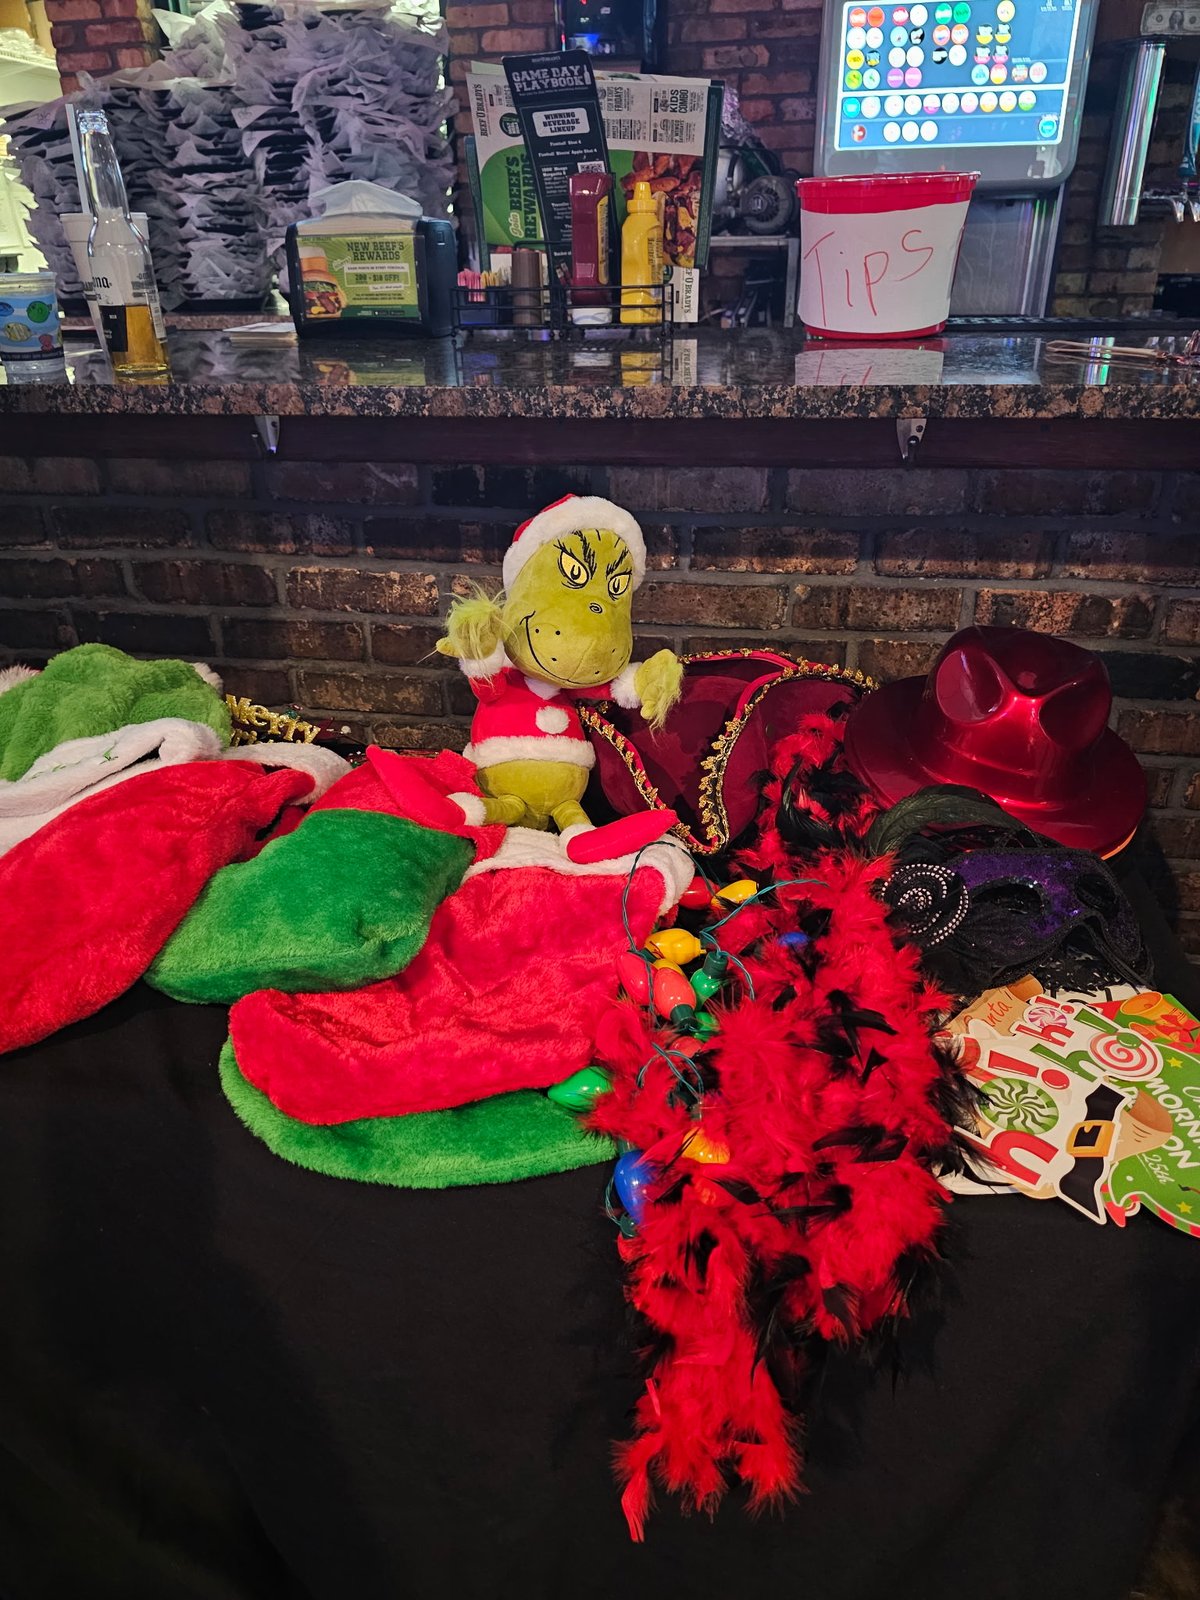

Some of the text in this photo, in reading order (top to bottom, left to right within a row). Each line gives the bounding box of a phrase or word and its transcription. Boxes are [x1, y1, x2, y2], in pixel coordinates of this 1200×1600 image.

[512, 65, 581, 82] GAME DAY
[514, 76, 584, 92] PLAYBOOK
[615, 87, 623, 111] FRIDAYS
[670, 89, 679, 113] KIDS
[679, 89, 689, 113] COMBO
[542, 119, 581, 127] BEVERAGE
[543, 112, 576, 120] WINNING
[505, 156, 524, 238] Join BEEF'S
[347, 241, 405, 251] NEW BEEF'S
[353, 251, 401, 261] REWARDS
[225, 693, 321, 745] Merry
[1141, 1152, 1175, 1185] 25th
